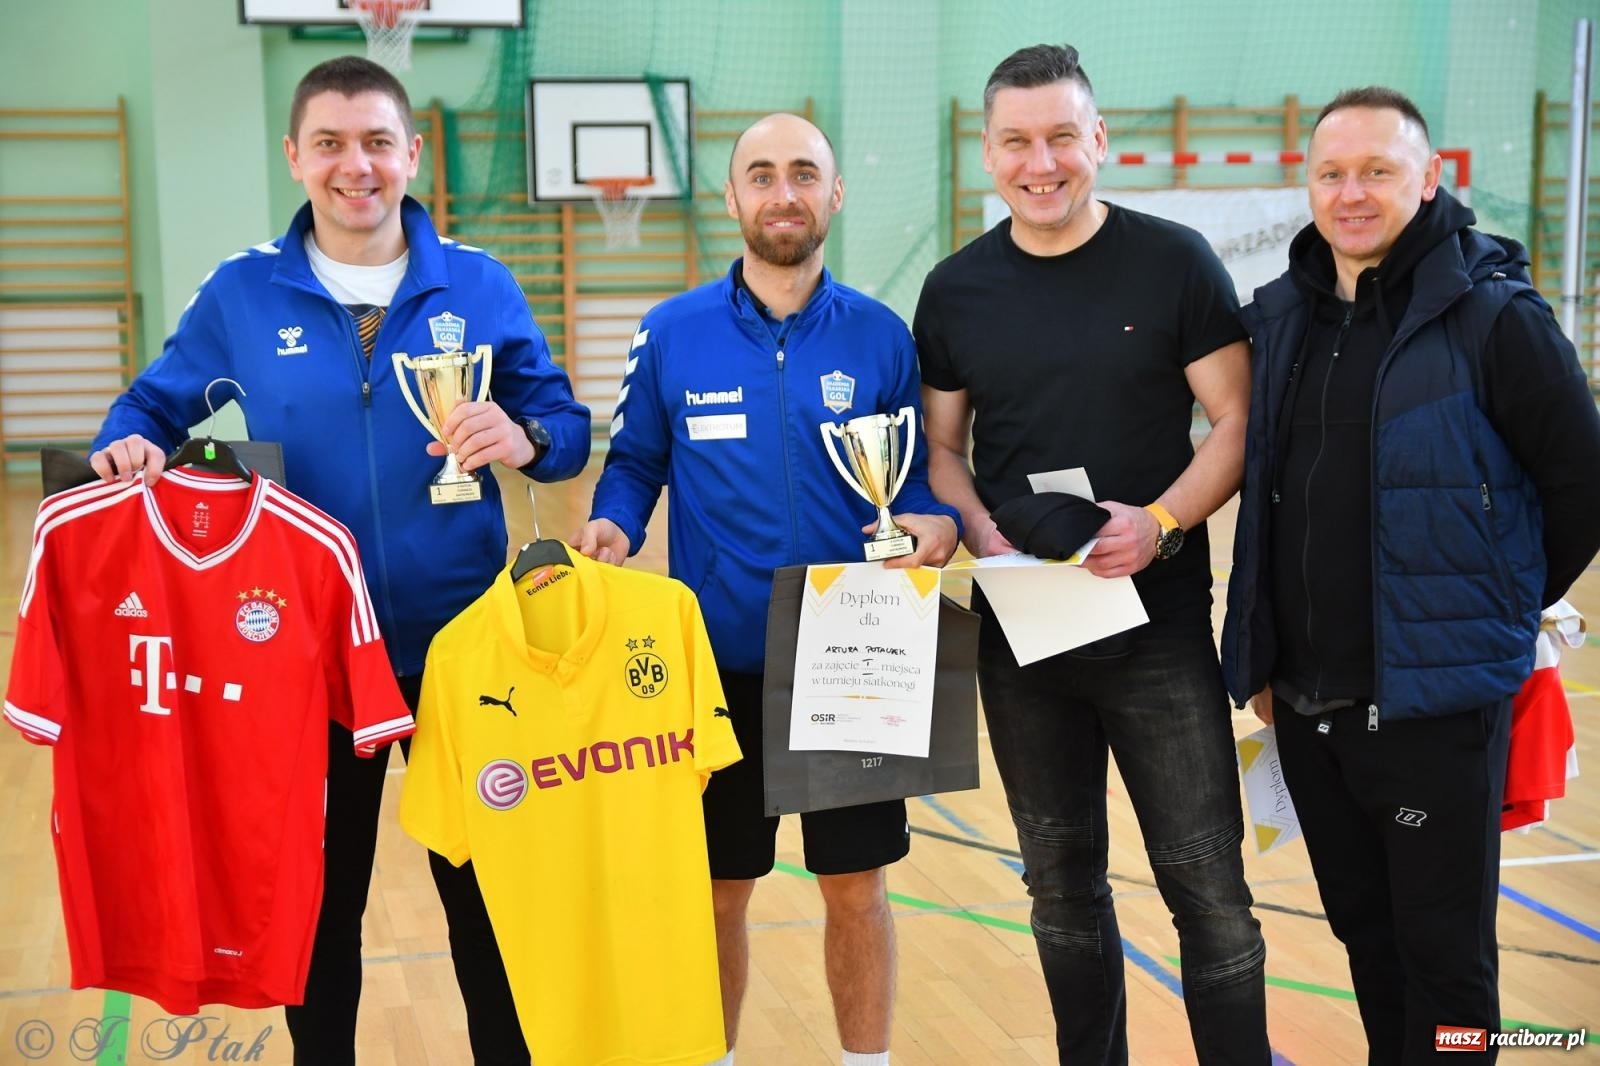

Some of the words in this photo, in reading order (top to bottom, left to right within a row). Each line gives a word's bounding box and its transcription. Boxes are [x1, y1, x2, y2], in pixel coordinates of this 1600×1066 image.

[440, 332, 459, 342] GOL
[276, 344, 308, 356] hummel
[685, 386, 743, 406] hummel
[829, 391, 848, 401] GOL
[840, 589, 901, 608] Dyplom
[114, 608, 148, 618] adidas
[859, 612, 880, 626] dla
[825, 645, 859, 654] ARTURA
[629, 656, 665, 687] BVB
[811, 661, 823, 670] za
[825, 660, 860, 672] zajęcie
[881, 662, 922, 676] miejsca
[641, 683, 655, 695] 09
[822, 676, 861, 688] turnieju
[863, 676, 916, 692] siatkonogi
[531, 728, 695, 790] EVONIK
[860, 756, 884, 769] 1217
[1269, 759, 1288, 813] Dyplom
